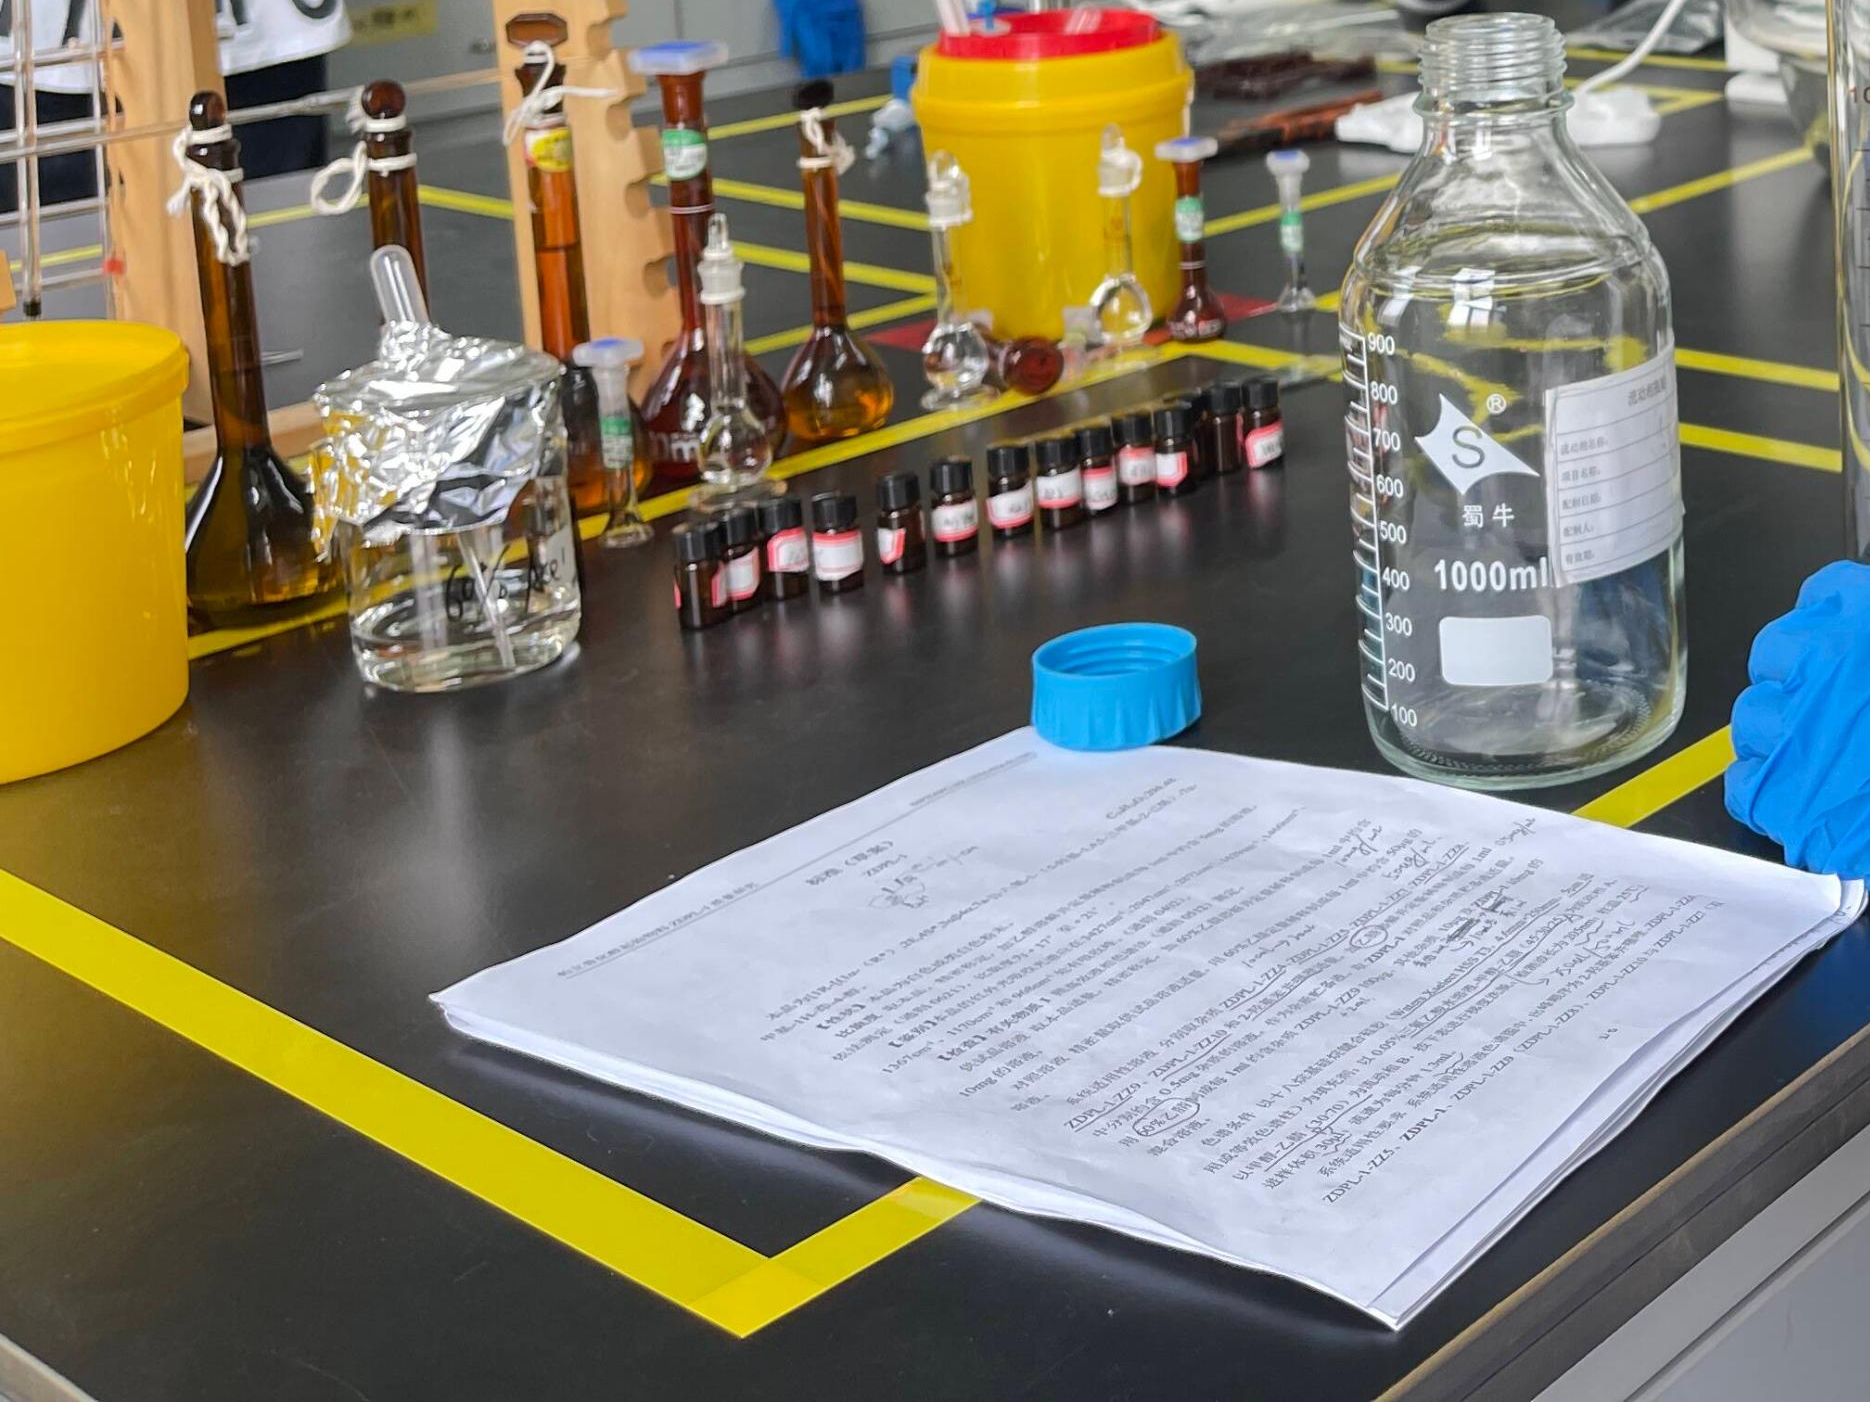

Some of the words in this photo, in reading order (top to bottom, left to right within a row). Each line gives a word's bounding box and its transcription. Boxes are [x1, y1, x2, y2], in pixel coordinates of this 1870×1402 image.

[1368, 332, 1396, 356] 900
[1370, 381, 1398, 405] 800
[1373, 427, 1401, 452] 700
[1452, 425, 1486, 469] S
[1376, 474, 1404, 498] 600
[1462, 502, 1516, 528] 蜀牛
[1379, 520, 1407, 544] 500
[1382, 566, 1410, 591] 400
[1434, 556, 1549, 593] 1000ml
[1385, 612, 1413, 637] 300
[1388, 658, 1416, 683] 200
[1390, 703, 1418, 728] 100
